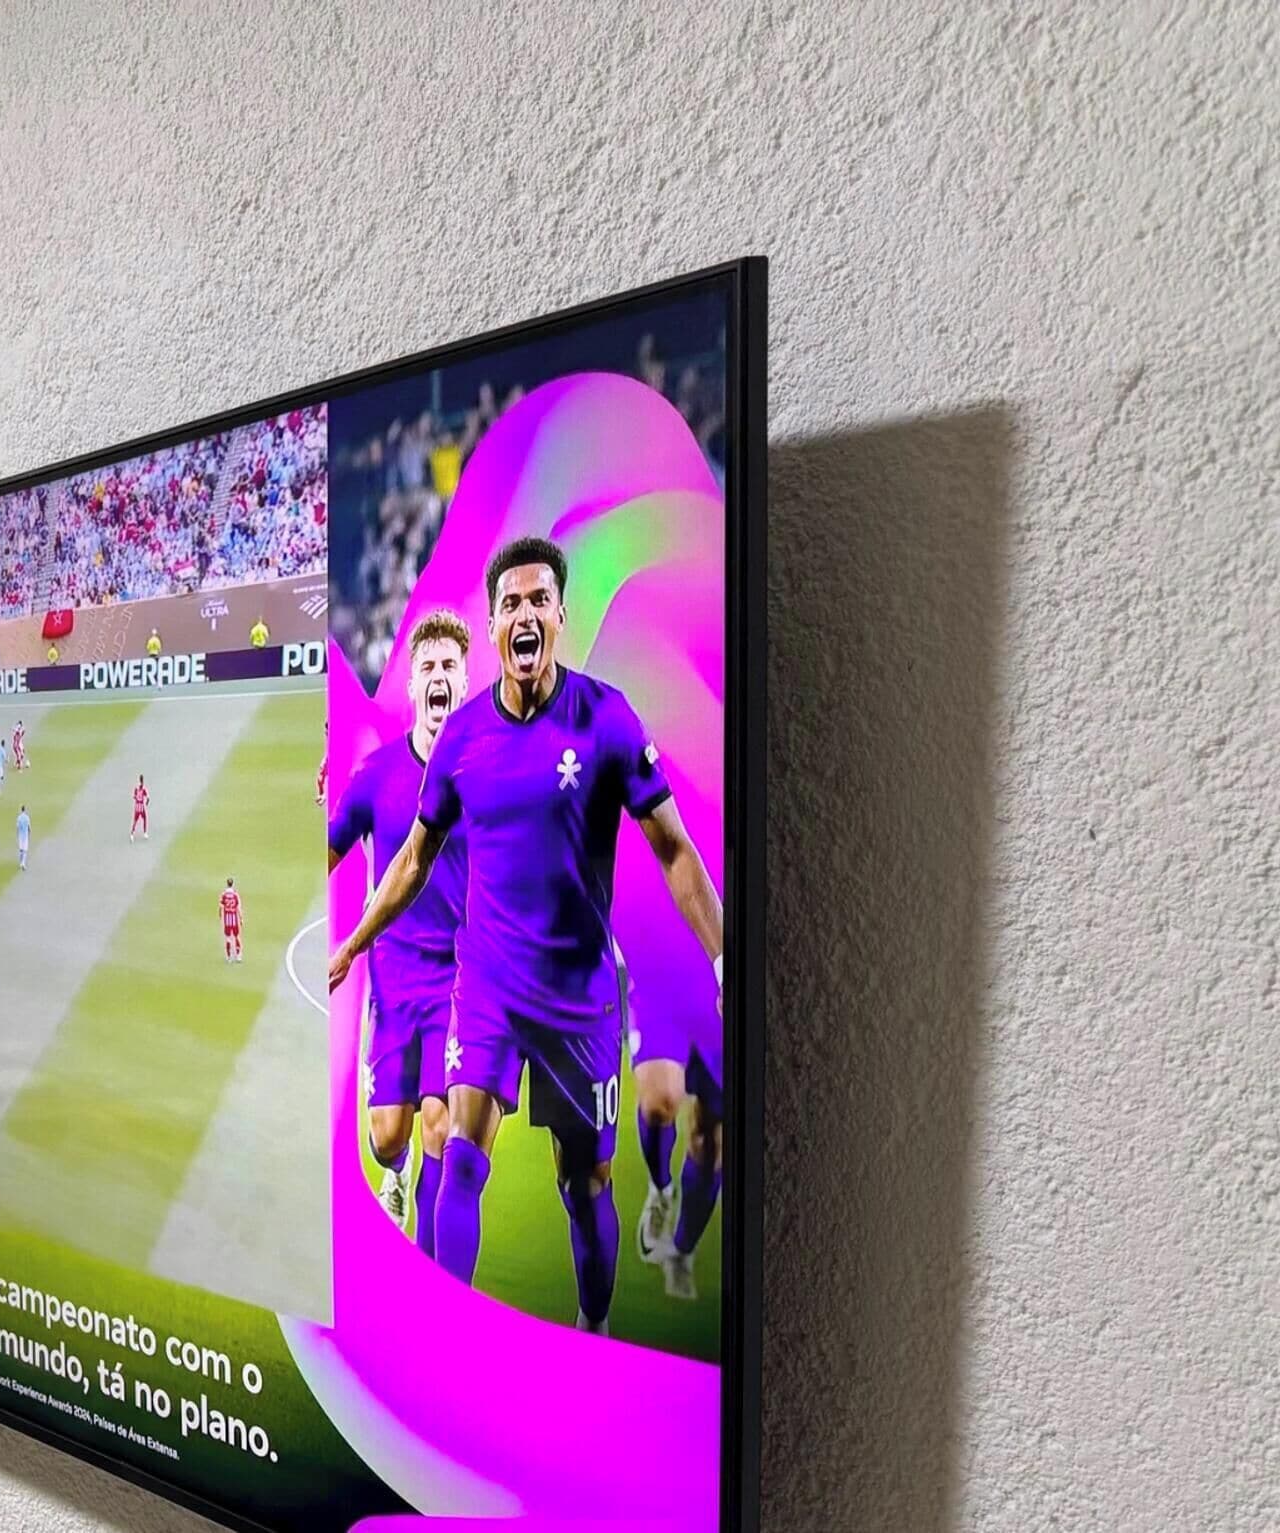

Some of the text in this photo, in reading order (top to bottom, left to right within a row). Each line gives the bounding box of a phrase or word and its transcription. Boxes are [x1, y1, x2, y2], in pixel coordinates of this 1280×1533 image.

[80, 653, 206, 690] POWERADE
[592, 1074, 618, 1131] 10
[165, 1335, 232, 1385] com
[242, 1362, 263, 1394] o
[97, 1358, 126, 1402] tá
[135, 1378, 171, 1419] no
[181, 1394, 279, 1463] plano.
